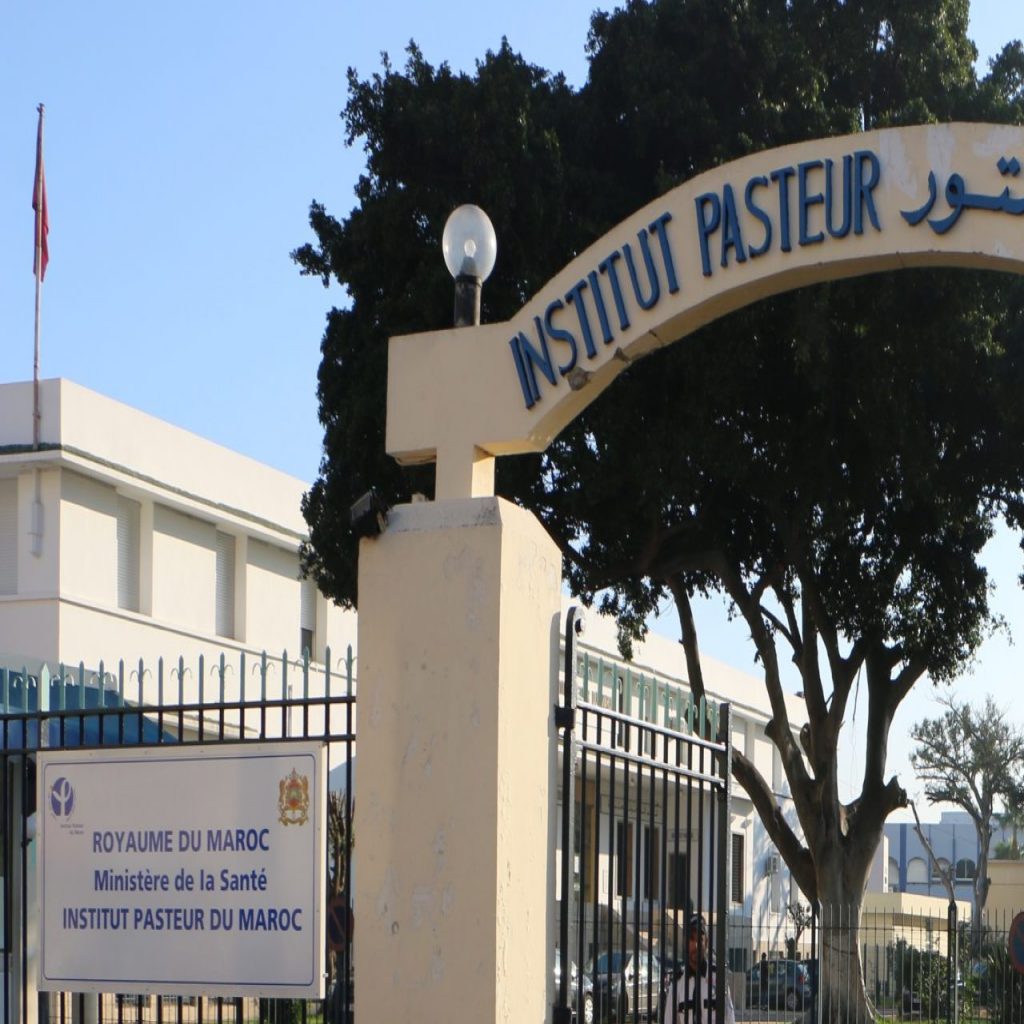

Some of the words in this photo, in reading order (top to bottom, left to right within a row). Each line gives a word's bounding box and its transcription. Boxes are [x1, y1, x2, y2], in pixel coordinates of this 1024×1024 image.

[509, 211, 681, 410] INSTITUT
[694, 150, 882, 277] PASTEUR
[92, 830, 173, 853] ROYAUME
[178, 830, 202, 852] DU
[206, 828, 270, 851] MAROC
[94, 868, 169, 892] Ministère
[174, 868, 195, 891] de
[200, 869, 215, 891] la
[220, 867, 268, 891] Santé
[62, 907, 130, 930] INSTITUT
[133, 908, 205, 931] PASTEUR
[209, 908, 233, 931] DU
[238, 908, 303, 931] MAROC
